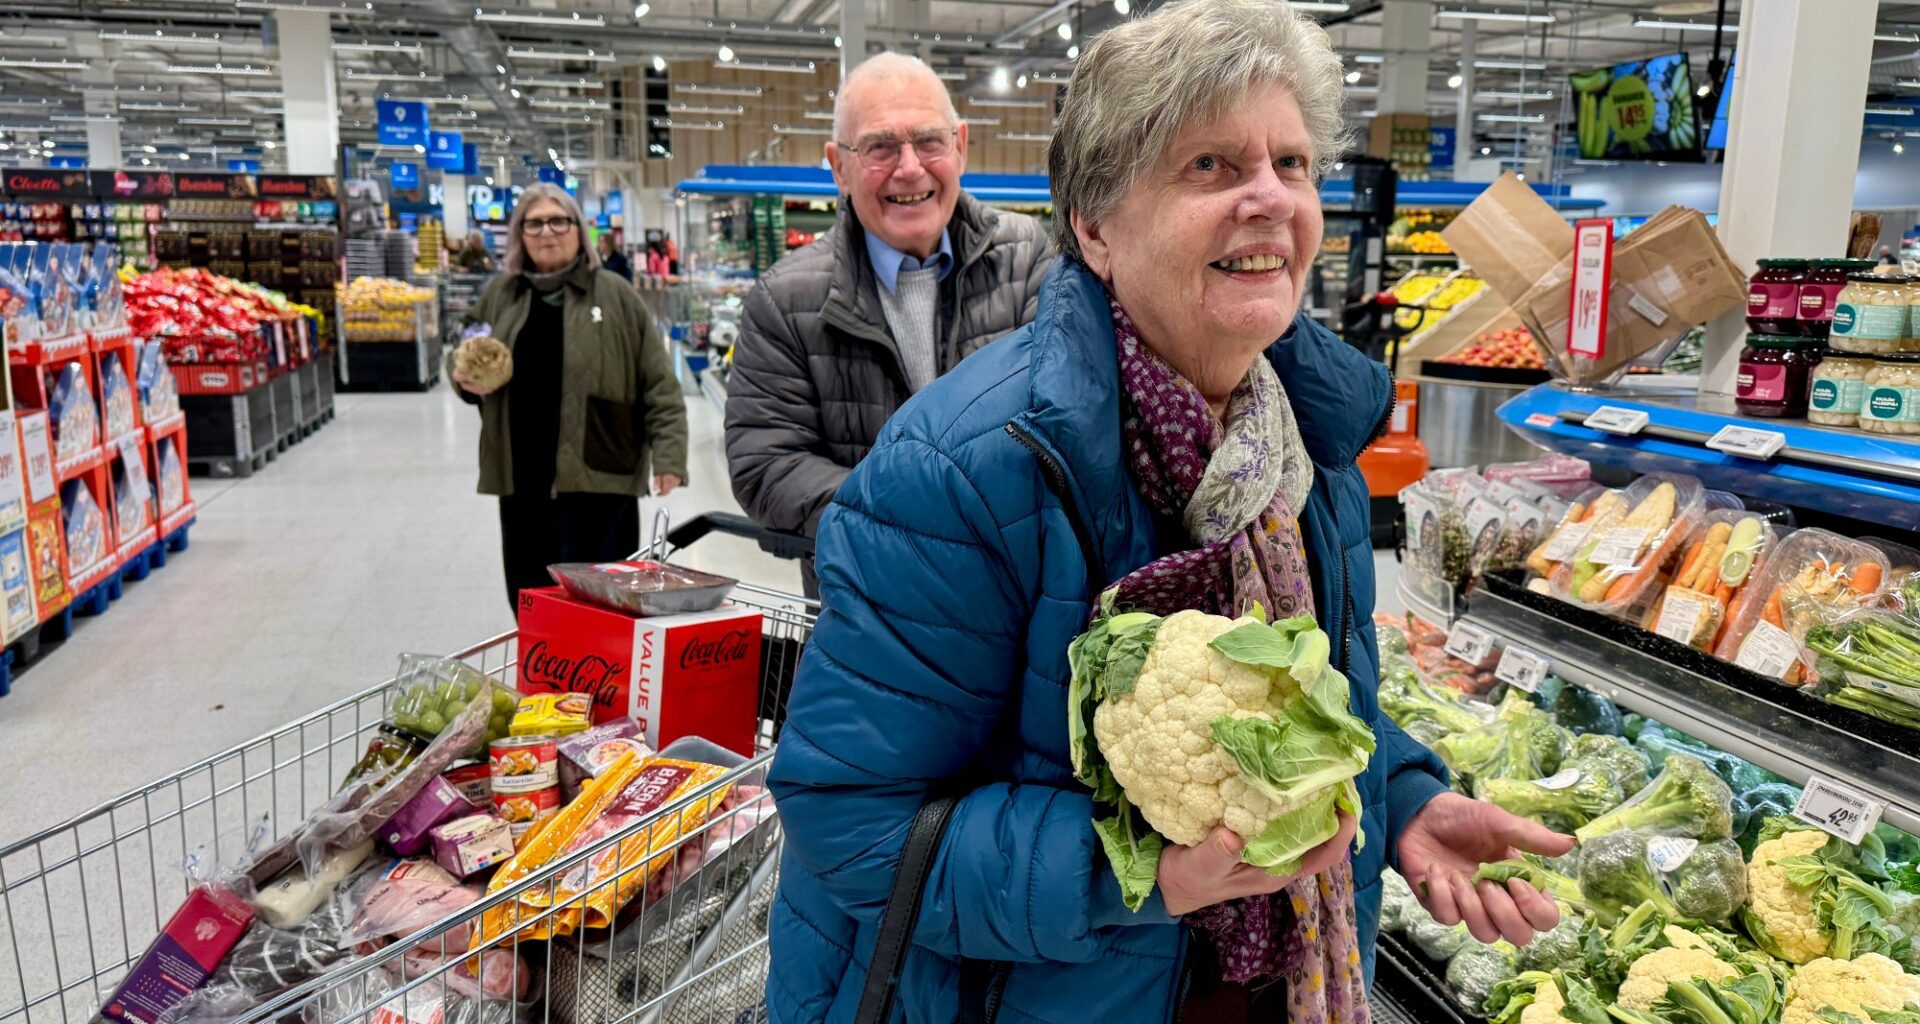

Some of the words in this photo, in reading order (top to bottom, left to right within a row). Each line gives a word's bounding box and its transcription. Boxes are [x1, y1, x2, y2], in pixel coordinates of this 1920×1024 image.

[393, 106, 407, 122] 9
[9, 175, 61, 191] Cloetta
[520, 593, 534, 607] 30
[680, 630, 752, 670] Coca-Cola
[523, 641, 625, 709] Coca-Cola
[636, 630, 654, 711] VALUE
[623, 767, 679, 811] BACON
[1828, 807, 1849, 827] 42
